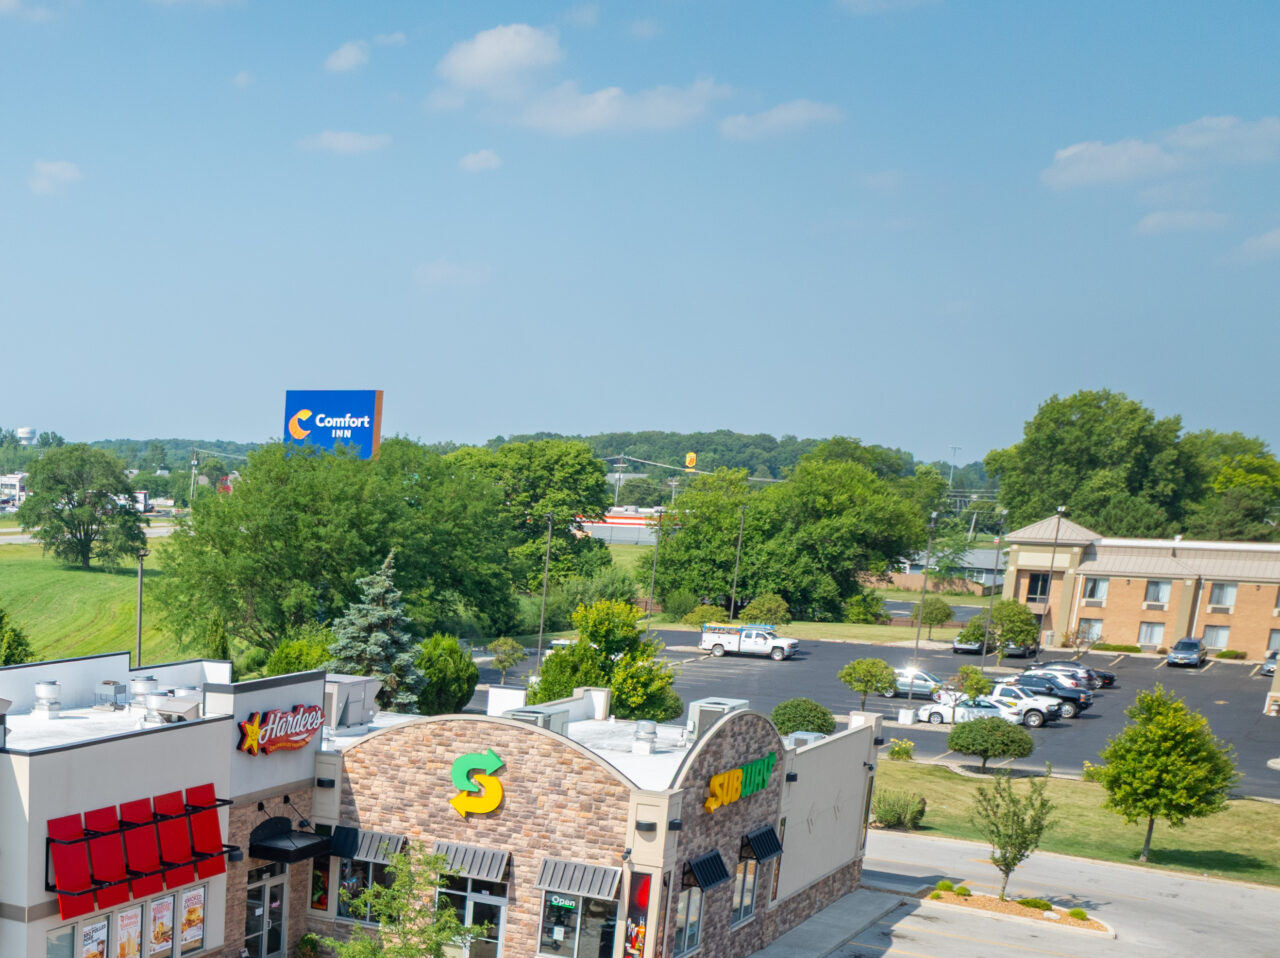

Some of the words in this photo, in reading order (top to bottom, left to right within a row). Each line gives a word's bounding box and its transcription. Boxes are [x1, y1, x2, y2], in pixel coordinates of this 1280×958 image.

[315, 413, 370, 428] Comfort
[331, 429, 352, 438] INN
[258, 706, 325, 744] Hardee's
[704, 752, 777, 814] SUBWAY
[551, 895, 576, 907] Open
